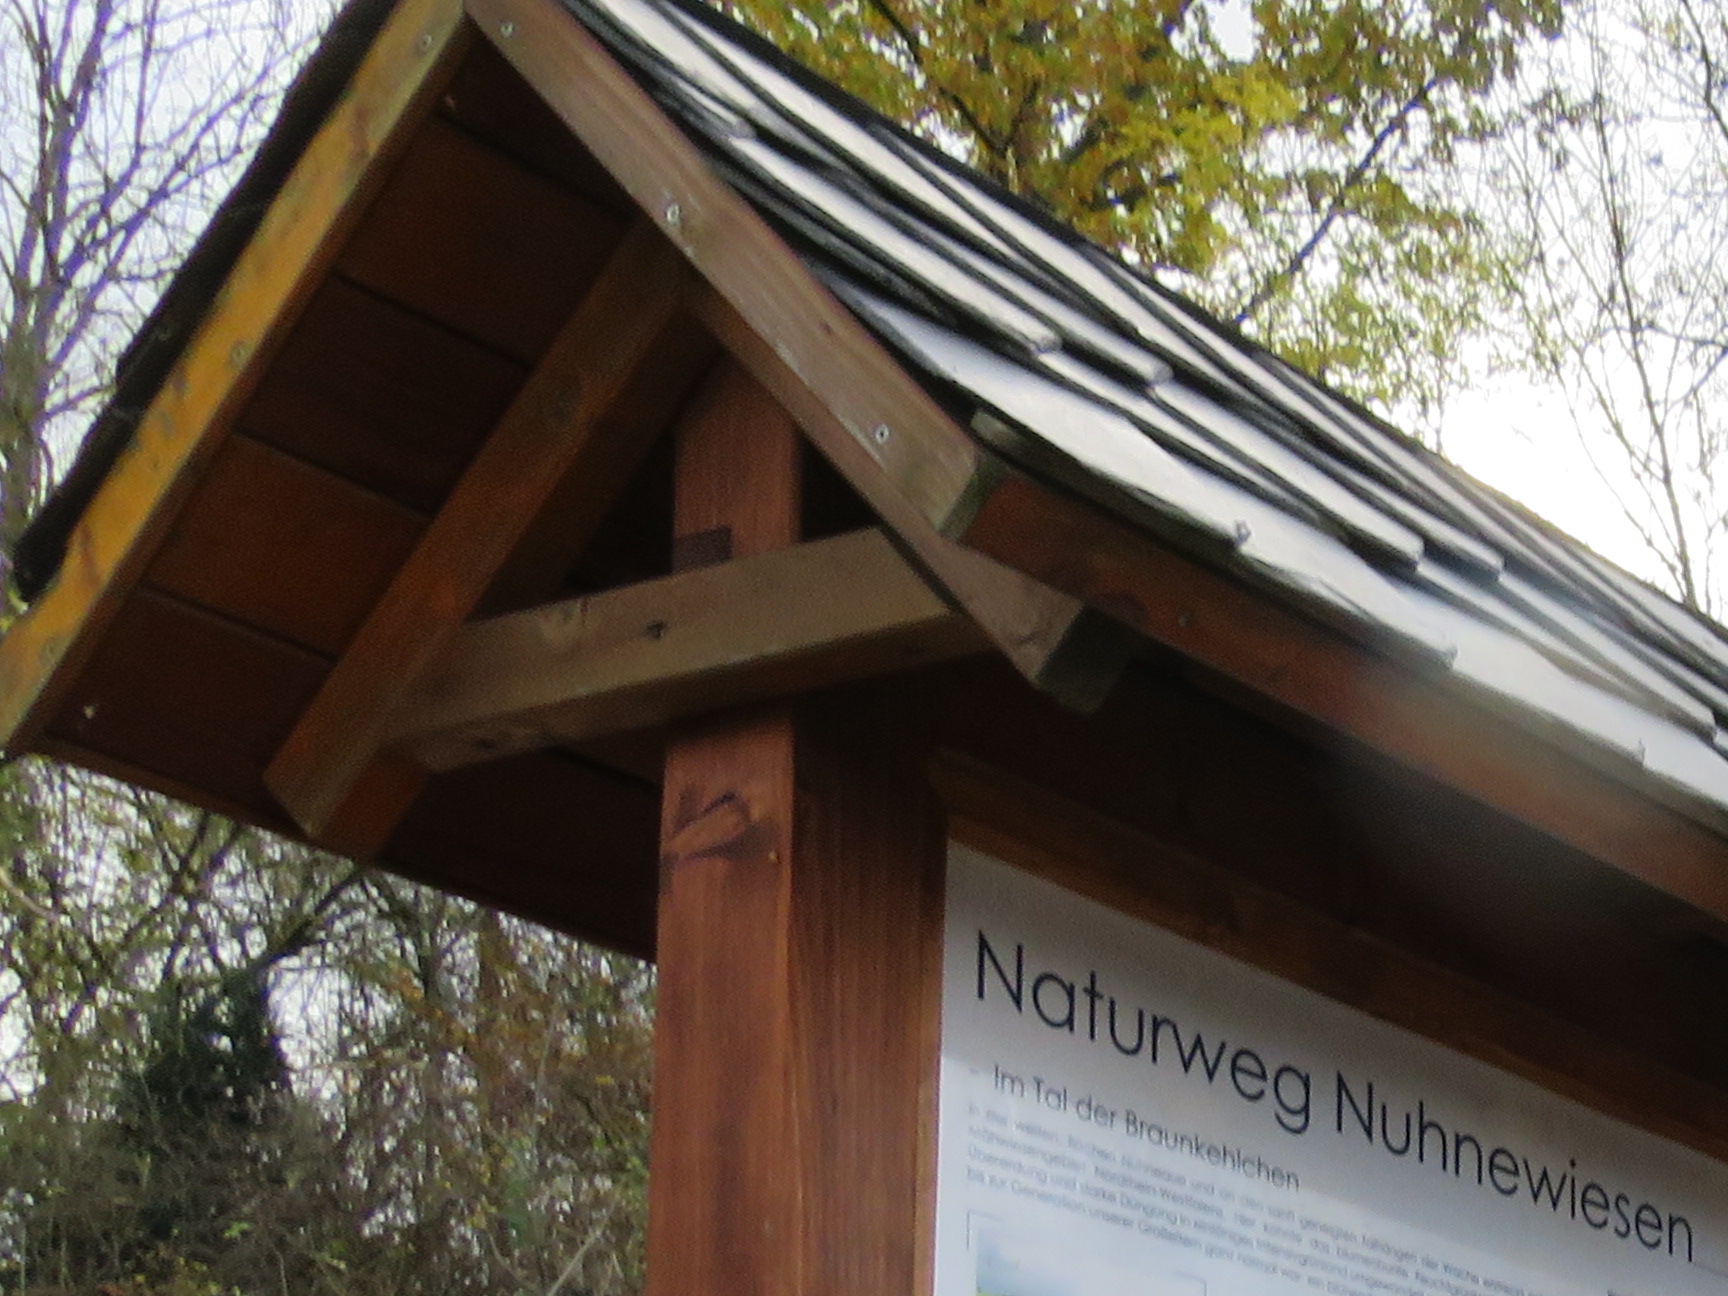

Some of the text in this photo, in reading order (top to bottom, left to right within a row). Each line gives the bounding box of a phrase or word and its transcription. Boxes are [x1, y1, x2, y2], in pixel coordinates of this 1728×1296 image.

[977, 929, 1311, 1134] Naturweg
[1337, 1070, 1694, 1262] Nuhnewiesen
[994, 1063, 1298, 1192] Im Tal der Braunkehlchen
